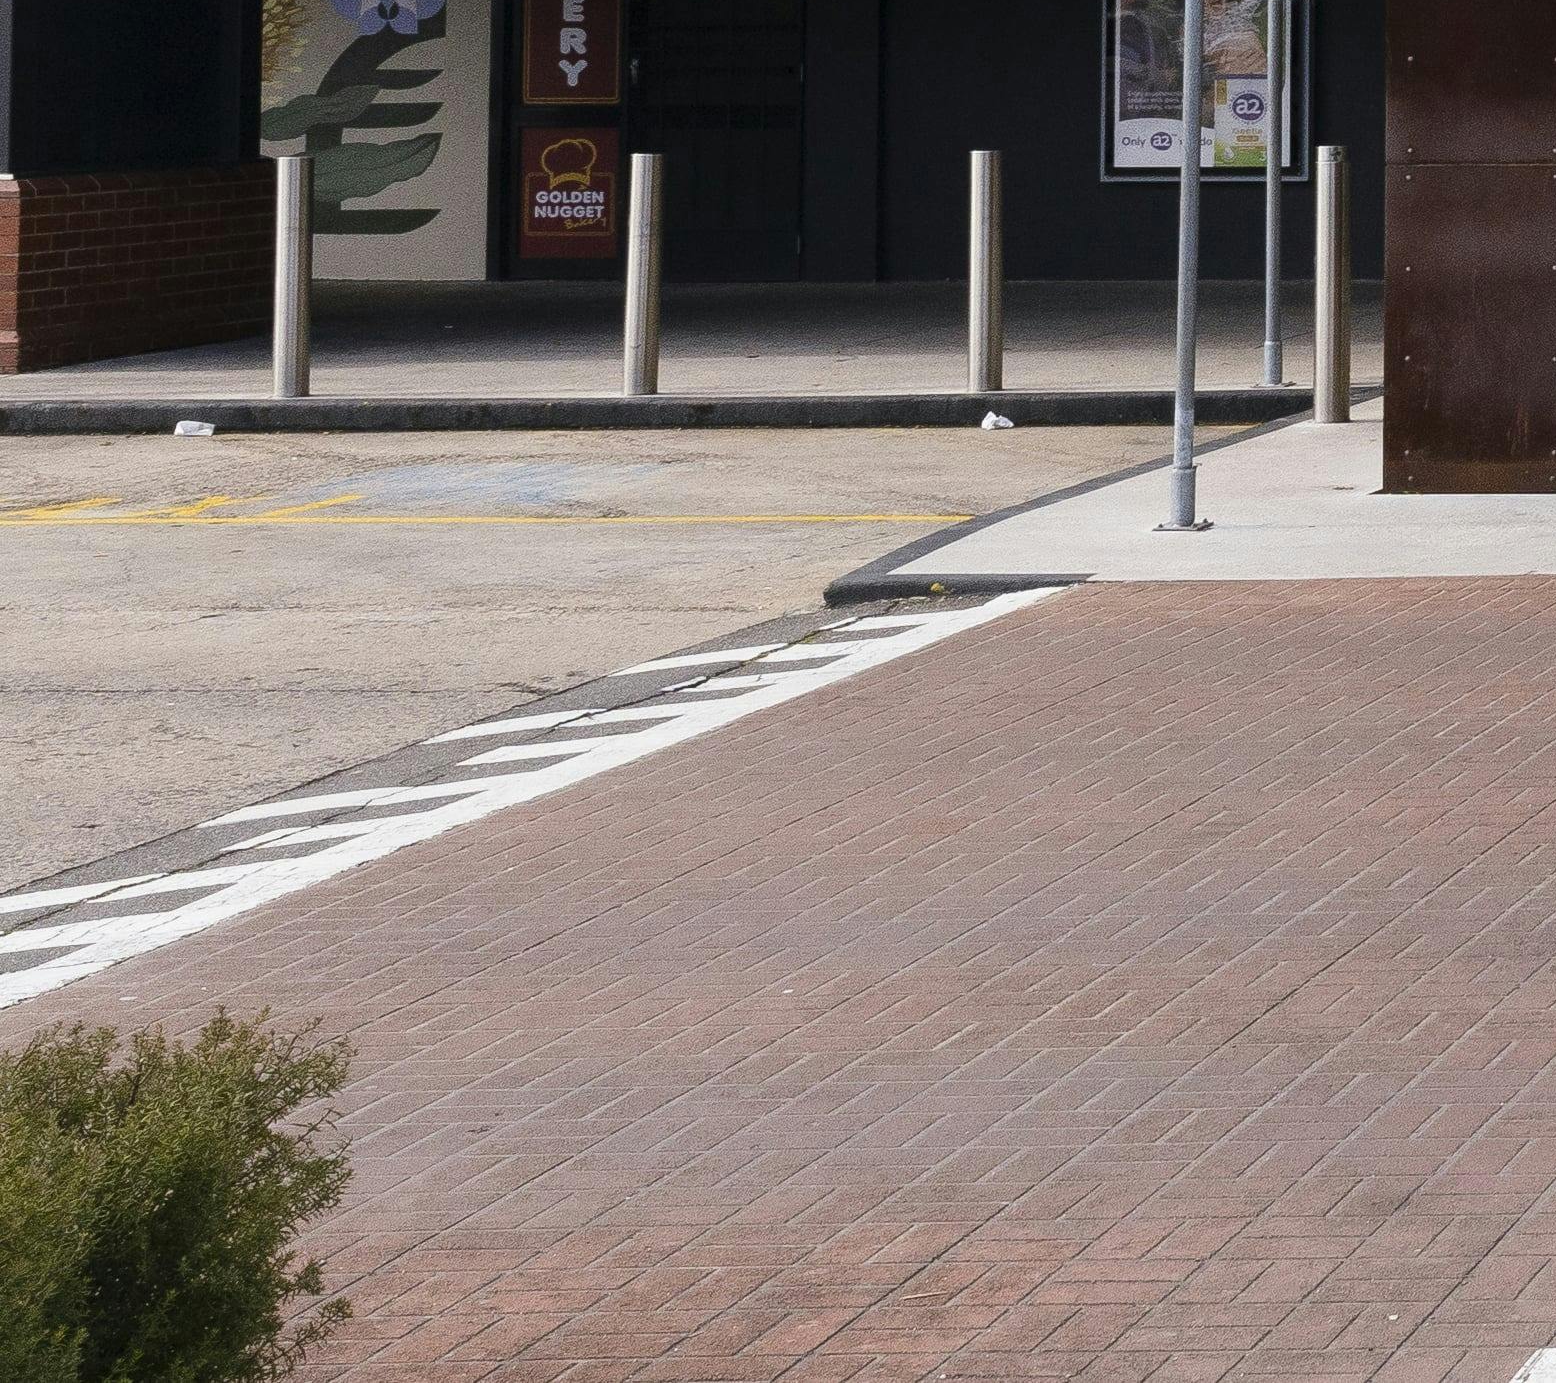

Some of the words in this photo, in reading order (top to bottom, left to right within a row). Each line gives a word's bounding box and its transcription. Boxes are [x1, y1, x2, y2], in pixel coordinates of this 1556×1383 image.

[1235, 98, 1261, 115] a2
[1121, 136, 1146, 147] Only
[535, 191, 605, 204] GOLDEN
[534, 205, 605, 218] NUGGET
